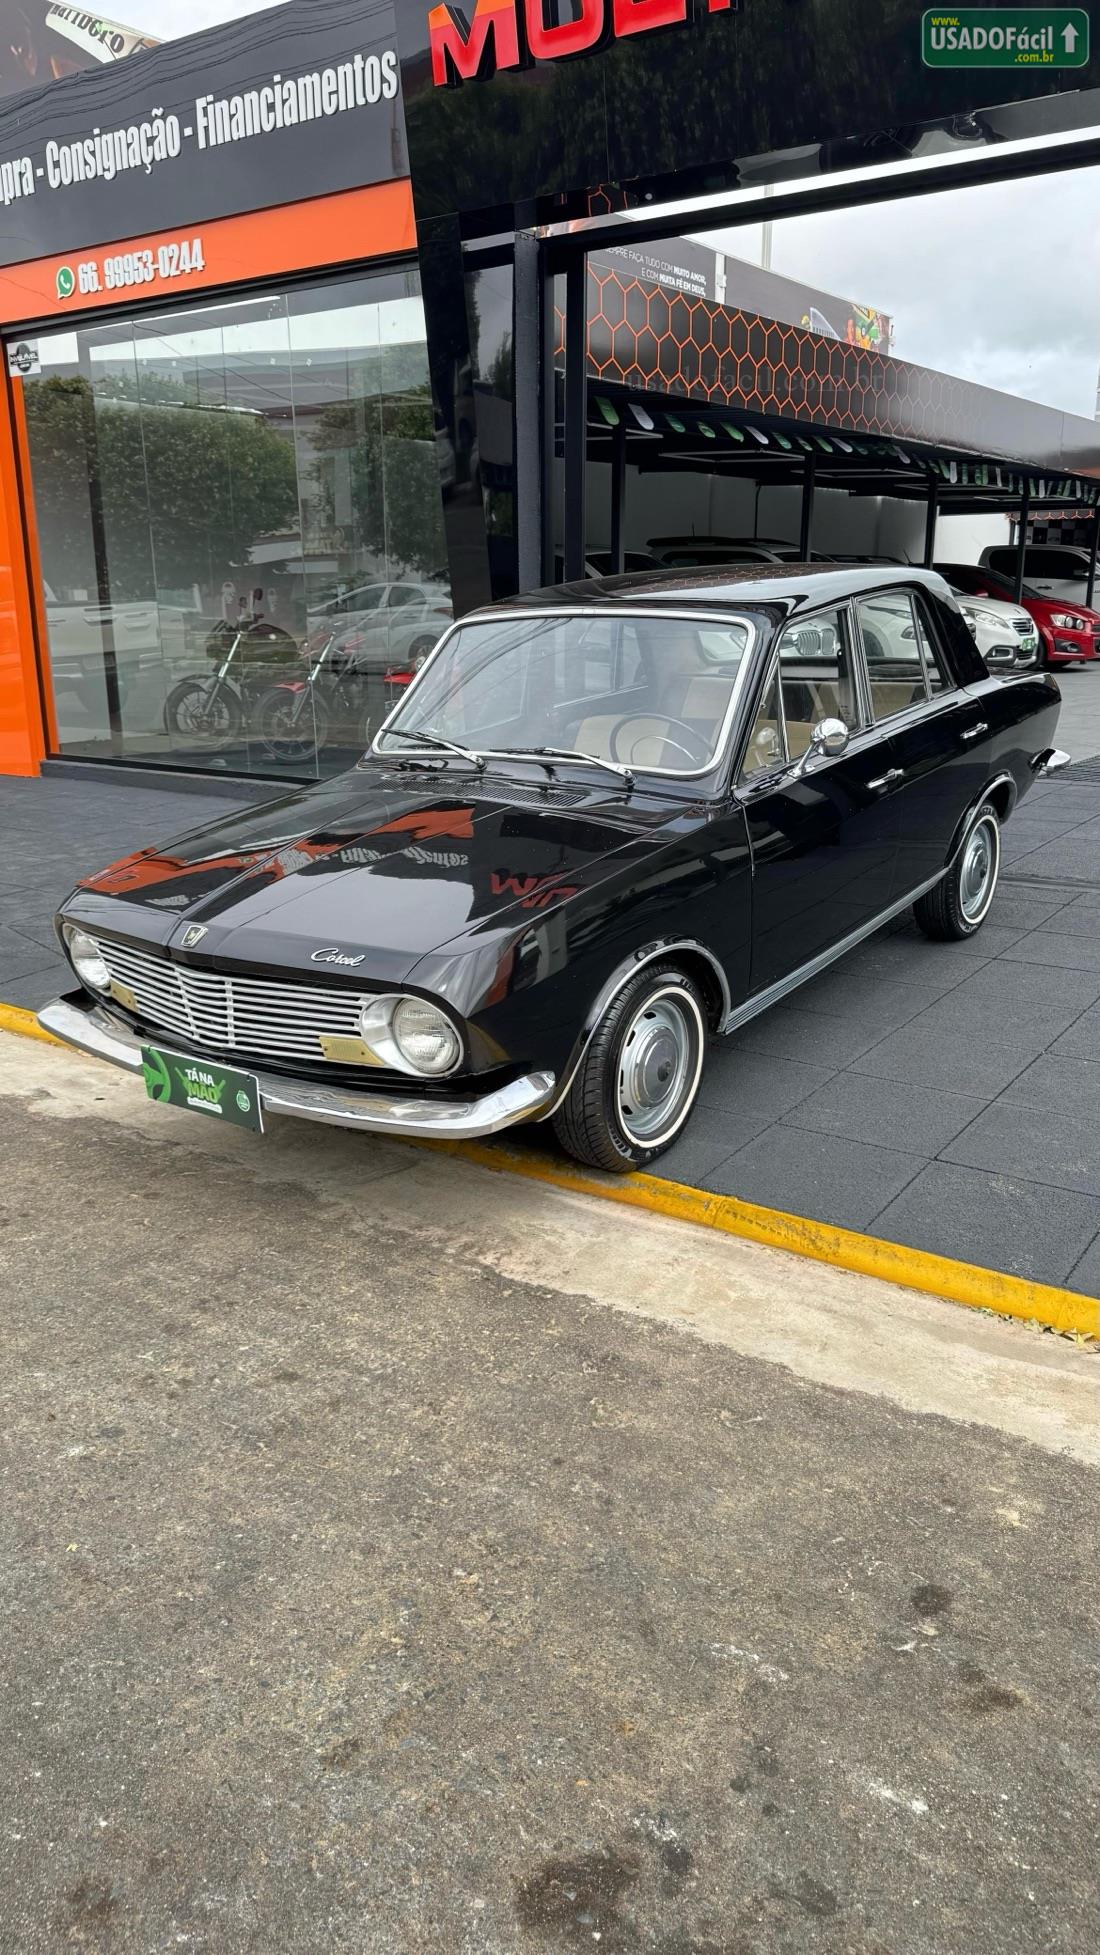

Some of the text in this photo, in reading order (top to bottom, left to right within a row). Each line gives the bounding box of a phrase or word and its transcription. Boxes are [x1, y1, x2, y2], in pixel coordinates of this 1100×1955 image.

[0, 156, 36, 205] pra
[46, 107, 181, 189] Consignação
[195, 50, 399, 149] Financiamentos
[78, 238, 206, 294] 66. 99953-0244
[644, 256, 660, 269] TUDO
[660, 261, 673, 273] COM
[673, 266, 690, 278] MUITO
[641, 267, 647, 277] E
[646, 269, 659, 281] COM
[659, 273, 676, 286] MUITA
[683, 281, 691, 291] EM
[310, 947, 366, 967] Corcel
[198, 1071, 215, 1087] NA
